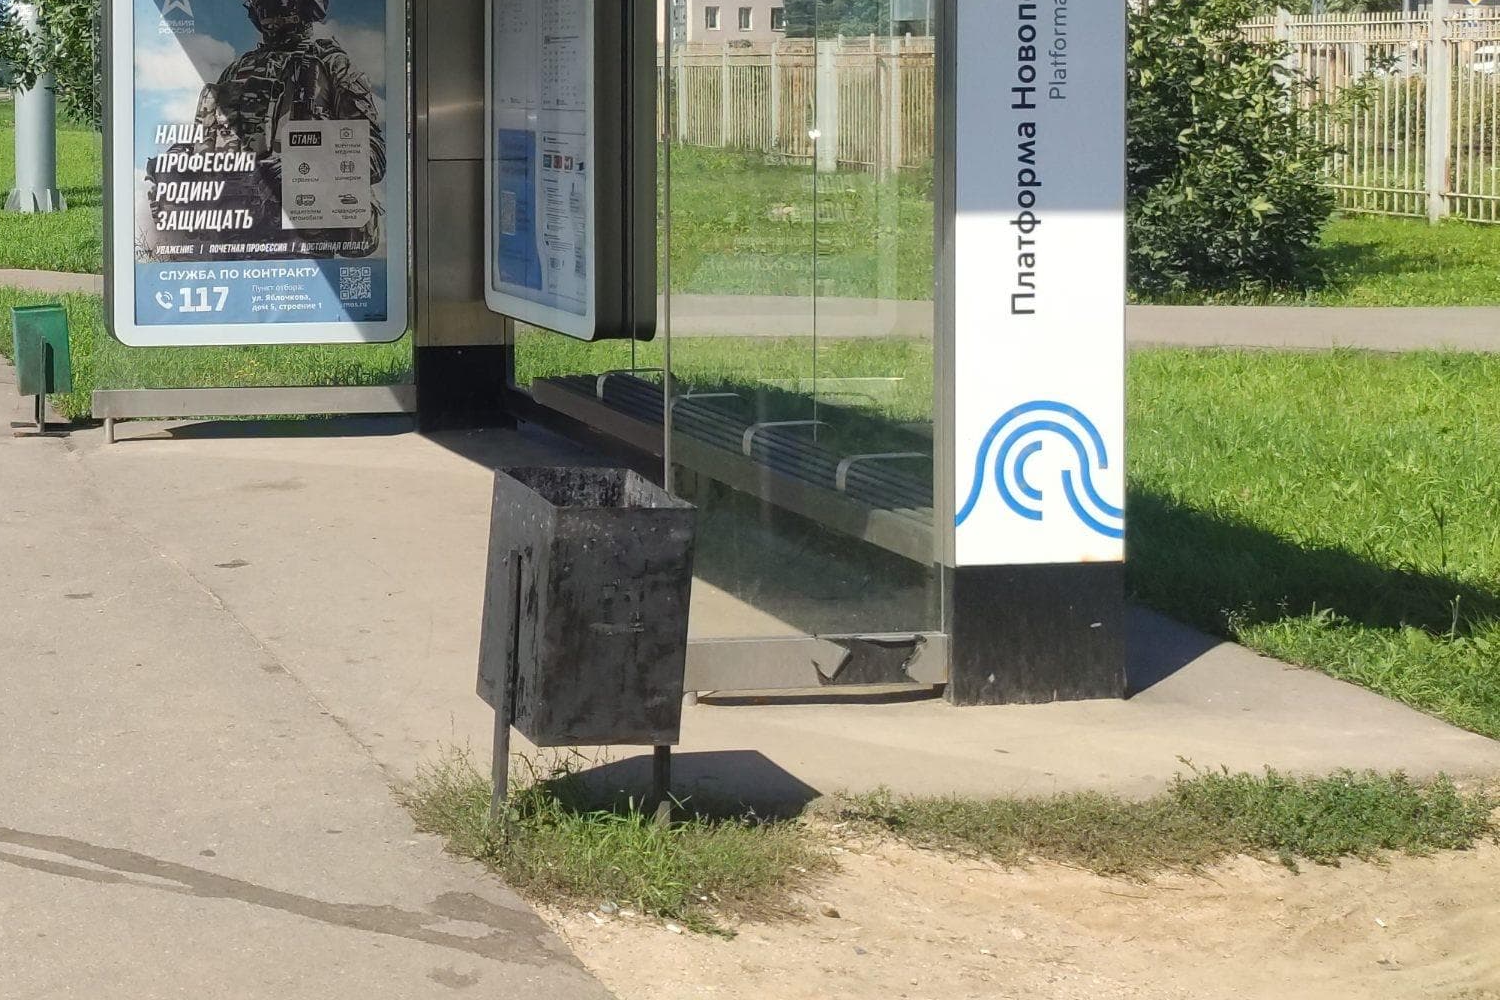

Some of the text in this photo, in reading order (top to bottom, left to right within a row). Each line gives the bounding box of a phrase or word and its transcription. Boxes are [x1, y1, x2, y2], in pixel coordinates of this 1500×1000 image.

[155, 124, 204, 144] НАША
[155, 152, 257, 173] ПРОФЕССИЯ
[155, 180, 225, 204] РОДИНУ
[156, 209, 254, 232] ЗАЩИЩАТЬ
[1009, 121, 1042, 315] Платформа
[155, 244, 195, 255] УВАЖЕНИЕ
[209, 243, 245, 254] ПОЧЕТНАЯ
[246, 242, 288, 253] ПРОФЕССИЯ
[342, 241, 370, 251] ОПЛАТА
[160, 267, 320, 281] СЛУЖБА ПО КОНТРАКТУ
[251, 284, 274, 293] Пункт
[178, 286, 229, 313] 117
[278, 303, 316, 312] строение
